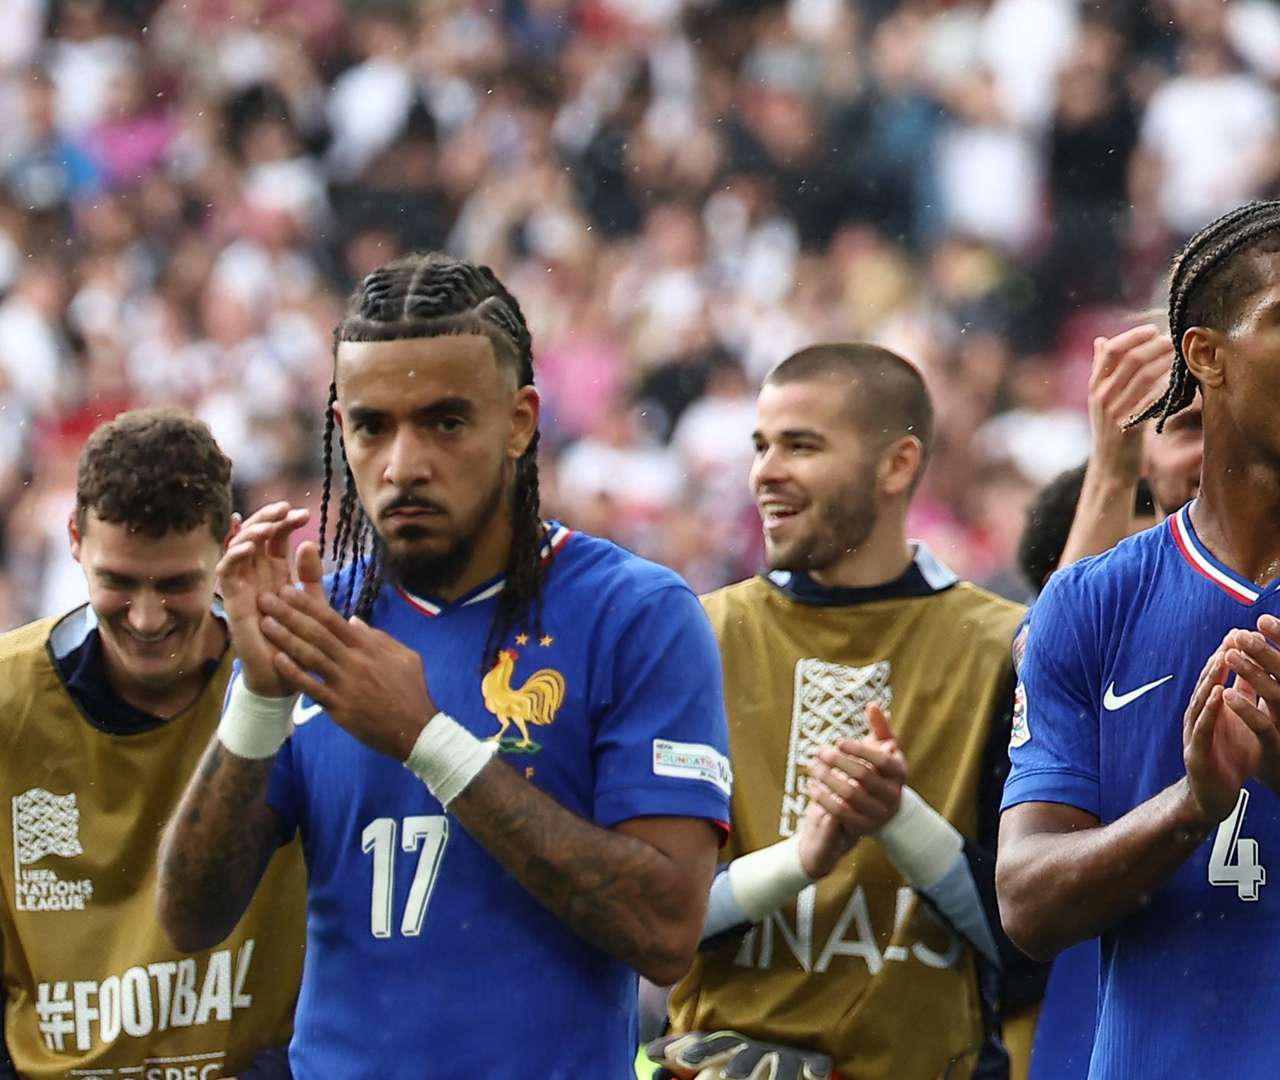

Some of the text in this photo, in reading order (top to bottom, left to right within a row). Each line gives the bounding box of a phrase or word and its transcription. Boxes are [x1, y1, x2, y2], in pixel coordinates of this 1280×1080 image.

[1208, 788, 1266, 901] 4
[21, 868, 58, 882] UEFA
[361, 815, 449, 938] 17
[15, 879, 95, 898] NATIONS
[15, 894, 87, 911] LEAGUE
